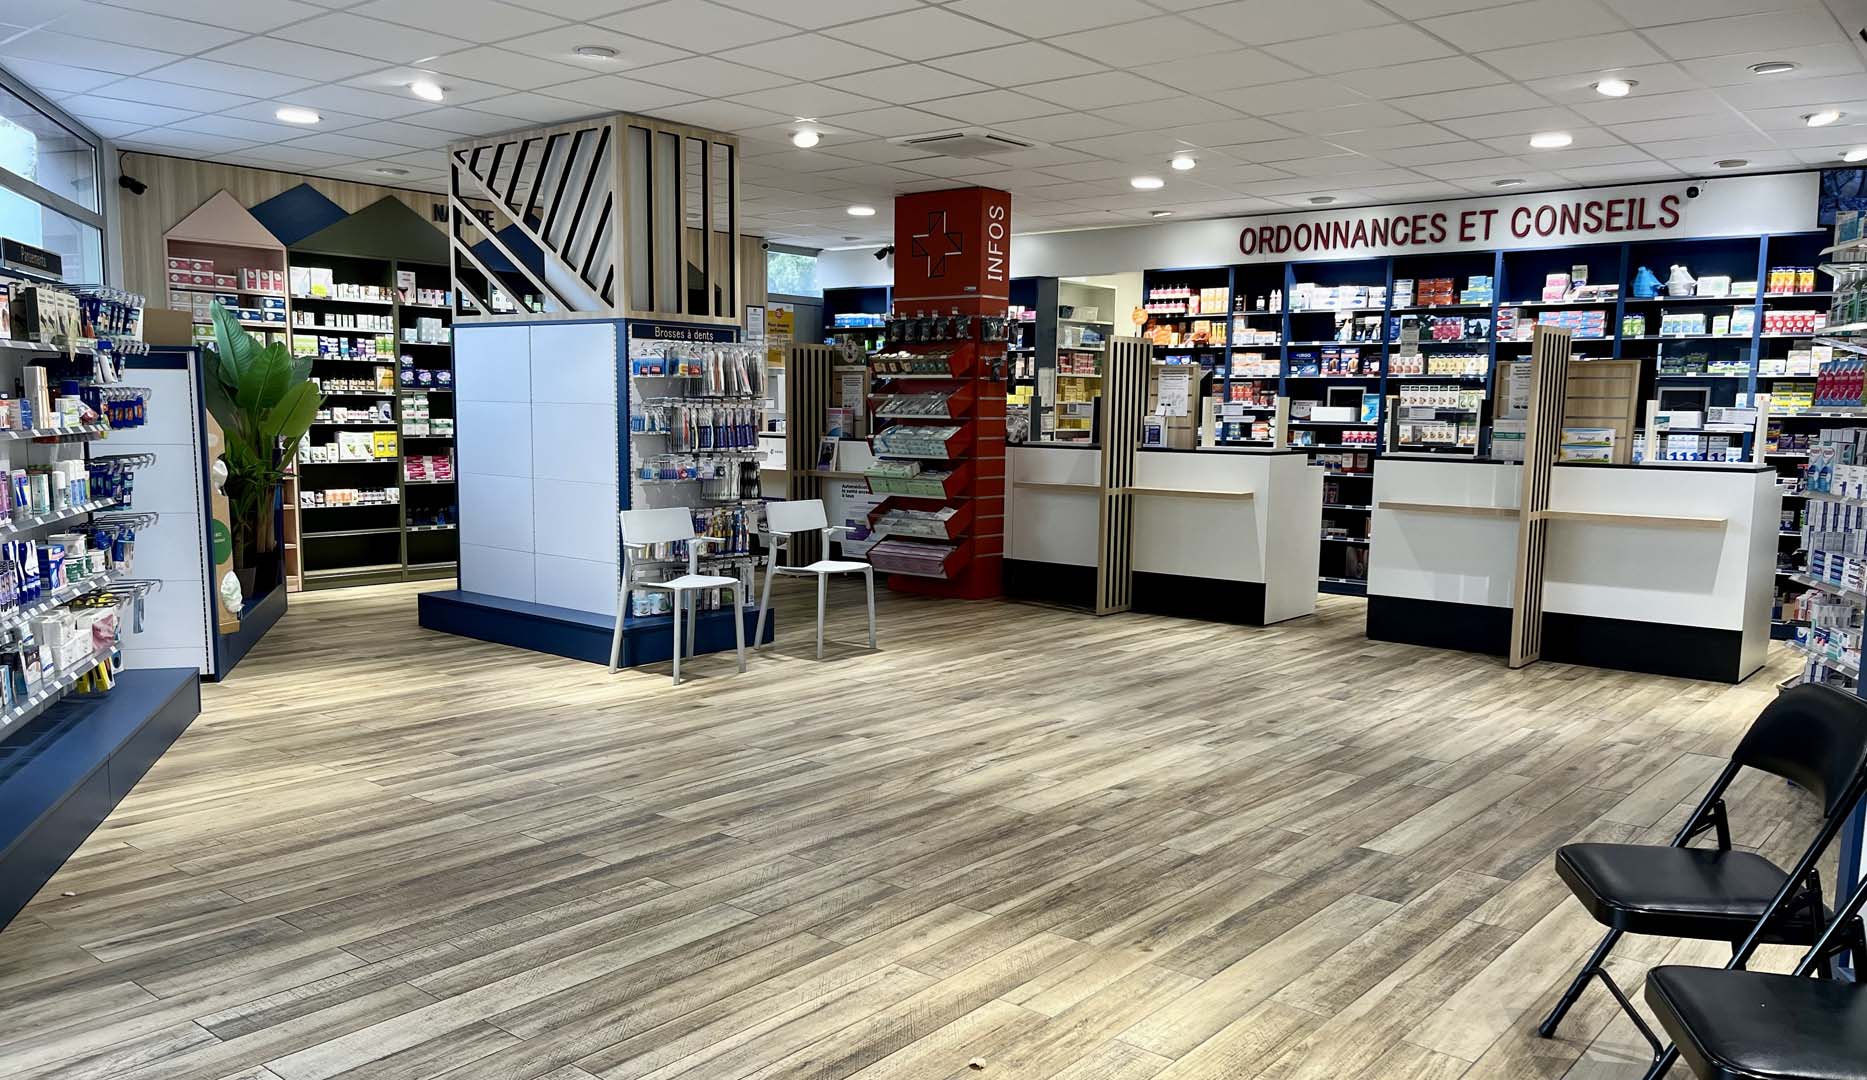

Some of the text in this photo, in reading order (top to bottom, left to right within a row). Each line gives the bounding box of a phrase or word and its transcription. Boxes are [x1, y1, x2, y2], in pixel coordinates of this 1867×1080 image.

[987, 205, 1005, 282] INFOS
[1239, 194, 1680, 255] ORDONNANCES ET CONSEILS
[654, 326, 714, 341] Brosses à dents
